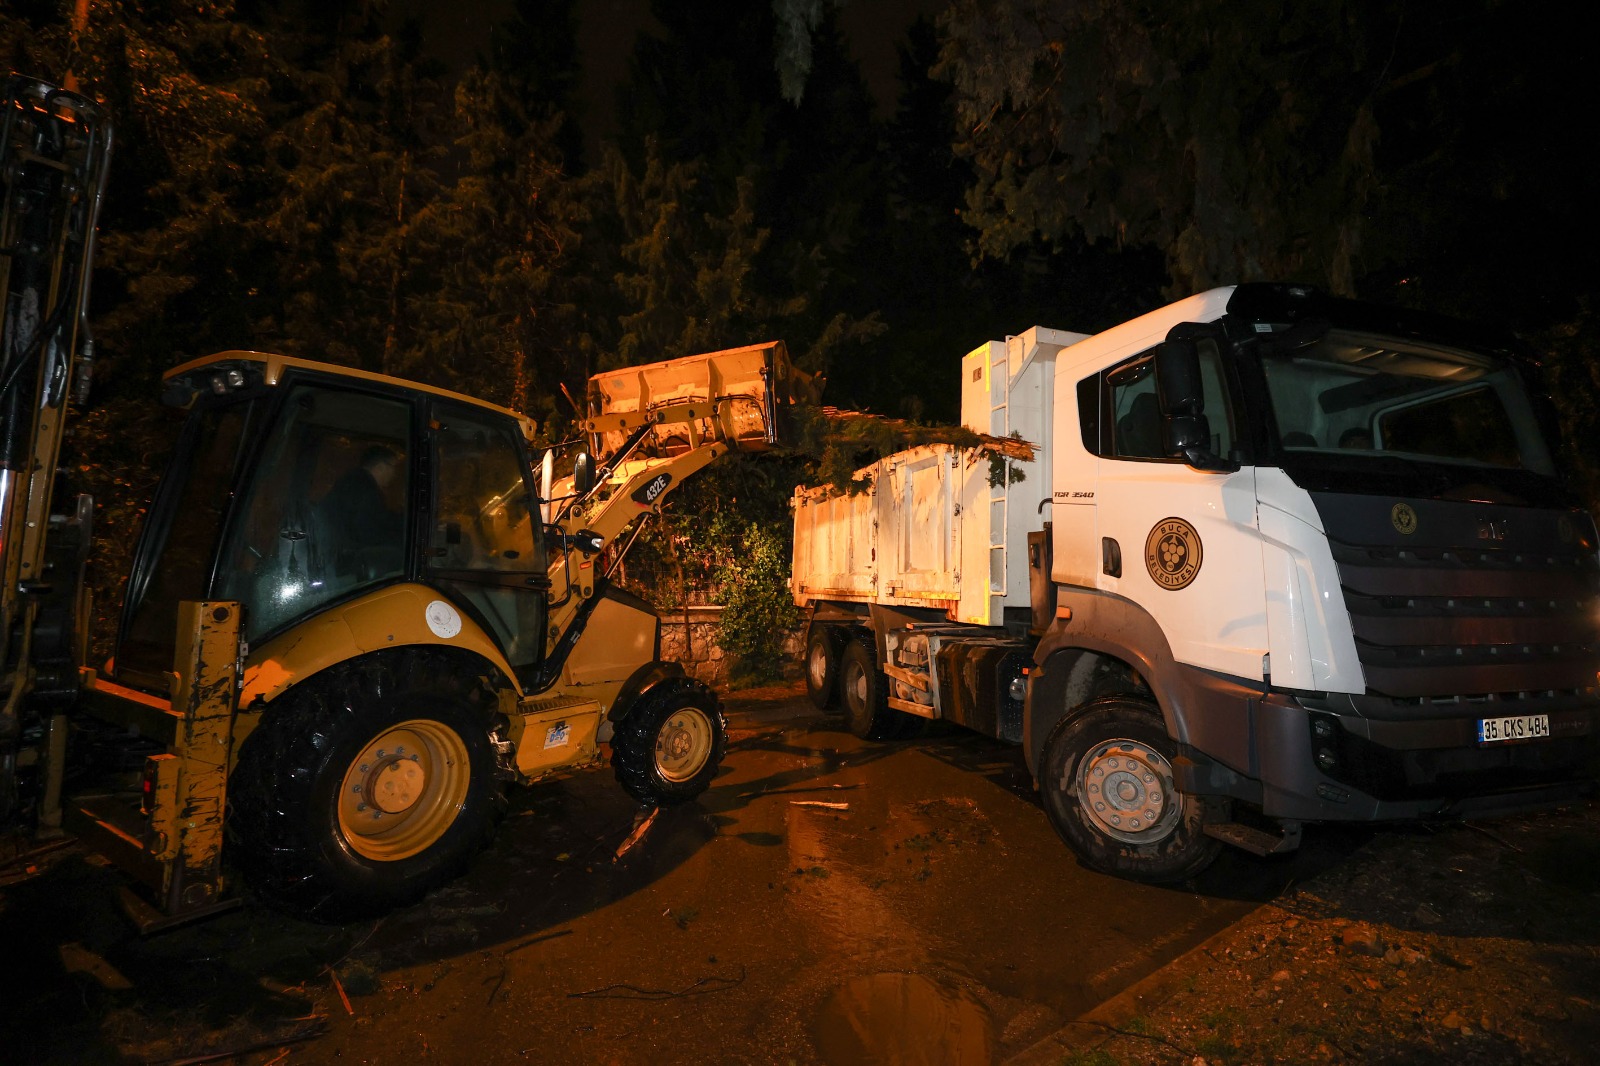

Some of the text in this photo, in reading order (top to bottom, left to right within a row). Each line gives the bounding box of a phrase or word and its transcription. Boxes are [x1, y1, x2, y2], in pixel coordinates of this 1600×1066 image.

[646, 475, 667, 501] 432E
[1161, 524, 1189, 539] BUCA
[1485, 721, 1498, 739] 35
[1504, 719, 1523, 737] CKS
[1528, 717, 1547, 735] 484
